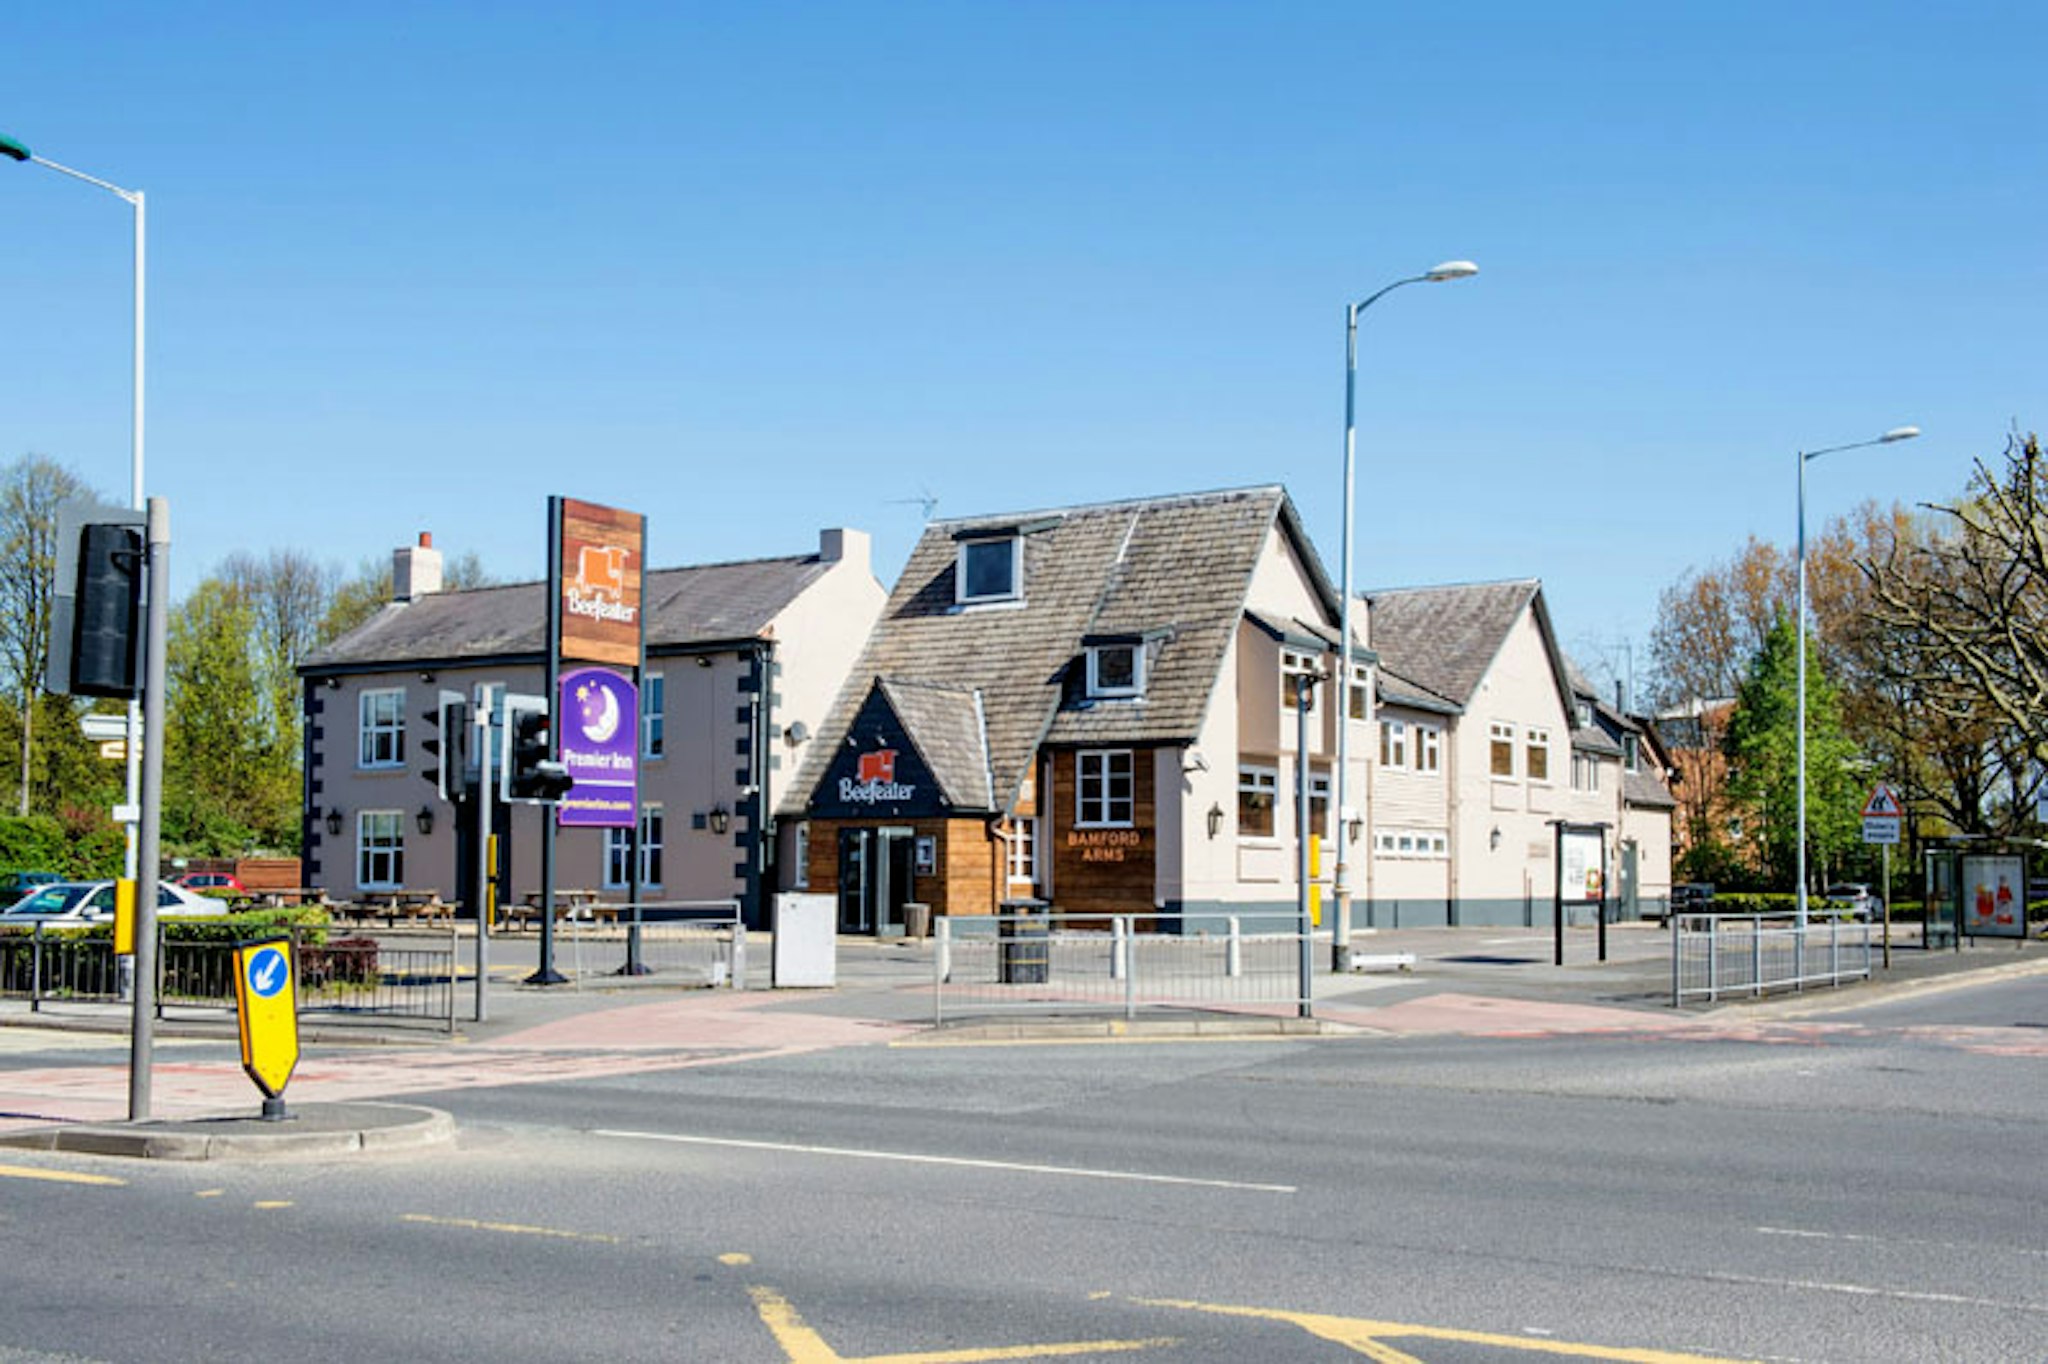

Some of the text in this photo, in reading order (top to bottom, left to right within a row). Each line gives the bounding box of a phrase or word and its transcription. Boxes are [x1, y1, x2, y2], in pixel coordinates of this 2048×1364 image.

[567, 587, 637, 622] Beefeater
[564, 749, 633, 771] Premier Inn
[839, 777, 916, 804] Beefeater
[1067, 831, 1140, 847] BAMFORD
[1082, 847, 1125, 862] ARMS
